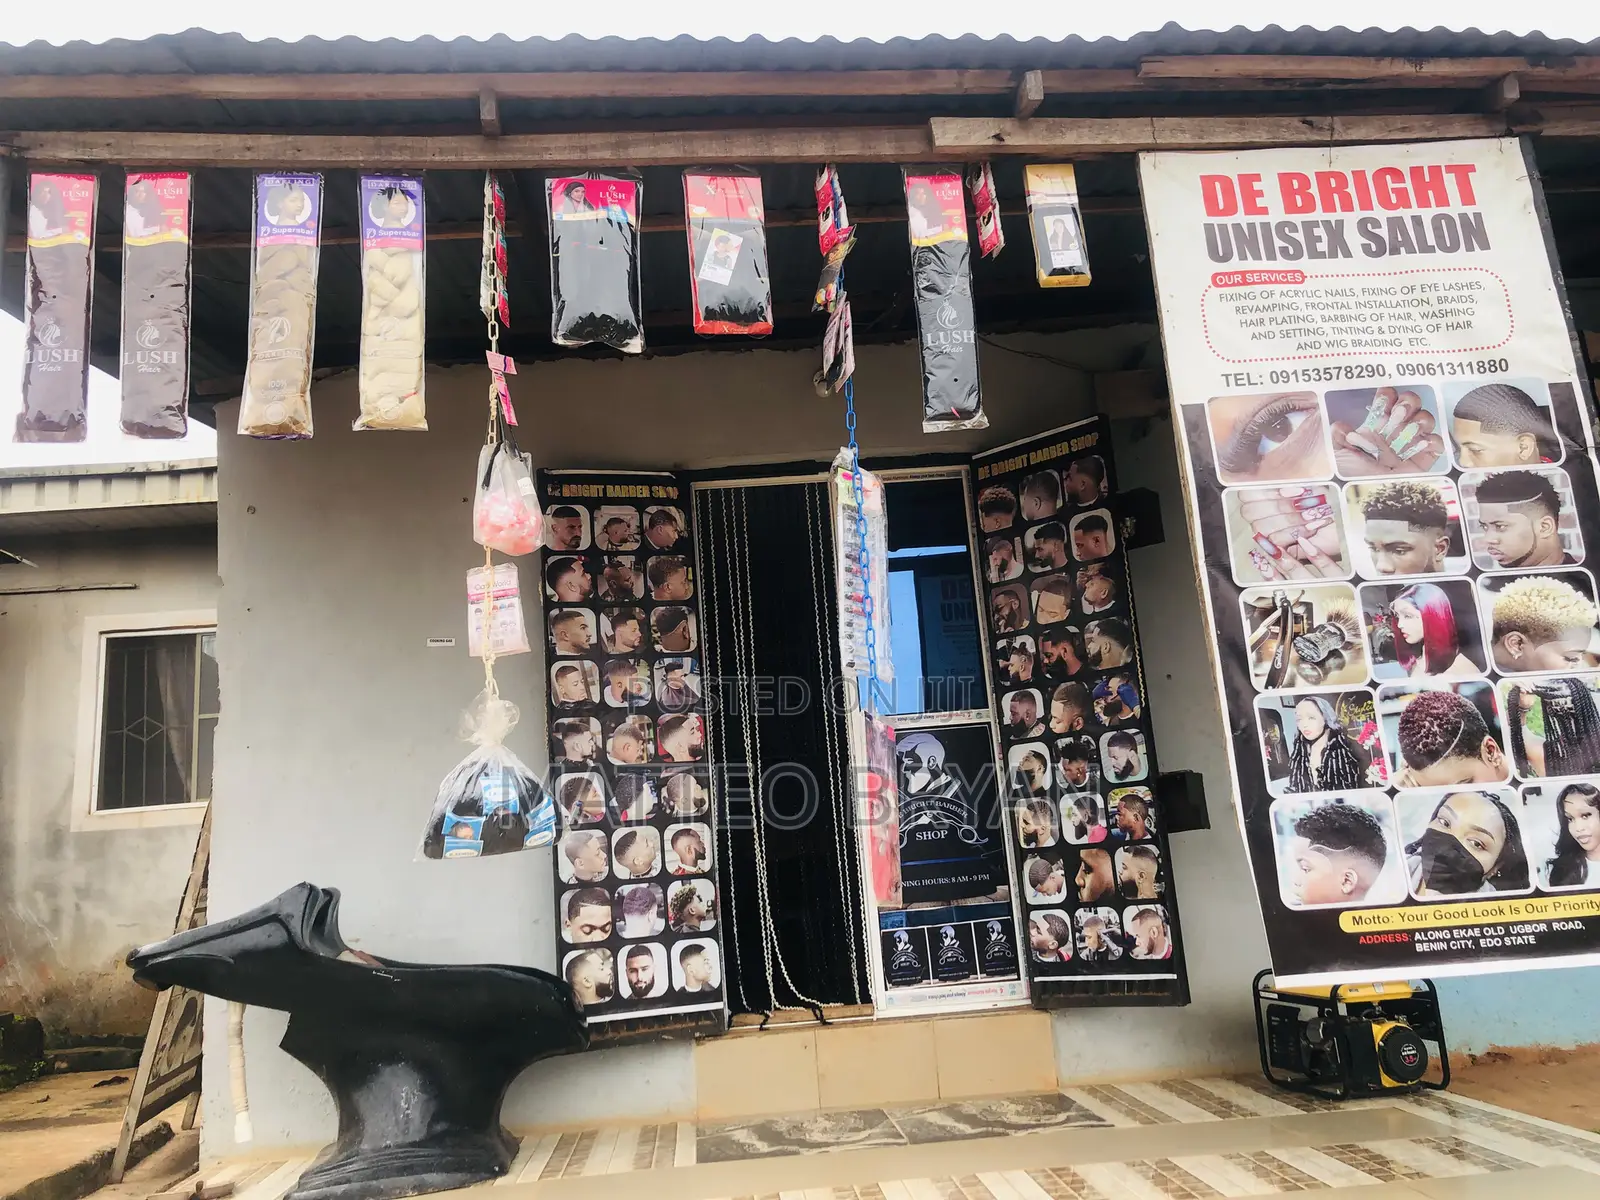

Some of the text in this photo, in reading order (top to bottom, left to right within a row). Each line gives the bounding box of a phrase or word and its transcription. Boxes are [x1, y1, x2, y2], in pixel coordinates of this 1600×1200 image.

[157, 187, 184, 195] LUSH
[600, 191, 626, 200] LUSH
[1199, 164, 1476, 217] DE BRIGHT
[1203, 212, 1491, 263] UNISEX SALON
[1216, 273, 1303, 285] OUR SERVICES
[1219, 281, 1485, 302] FIXING OF ACRYLIC NAILS, FIXING OF EYE LASHES,
[1235, 295, 1478, 315] REVAMPING, FRONTAL INSTALLATION, BRAIDS,
[1239, 308, 1475, 328] HAIR PLATING, BARBING OF HAIR, WASHING
[926, 330, 975, 346] LUSH
[1250, 321, 1474, 341] AND SETTING, TINTING & DYING OF HAIR
[941, 344, 963, 353] Hair
[1296, 338, 1431, 351] AND WIG BRAIDING ETC.
[25, 349, 78, 364] LUSH
[124, 351, 177, 366] LUSH
[37, 363, 62, 372] Hair
[137, 364, 161, 373] Hair
[1221, 358, 1509, 387] TEL: 09153578290, 09061311880
[978, 432, 1099, 480] DE BRIGHT BARBER SHOP
[562, 484, 604, 497] BRIGHT
[606, 485, 650, 497] BARBER
[651, 486, 678, 500] SHOP
[936, 801, 968, 819] BARBER
[916, 830, 948, 841] SHOP
[900, 880, 921, 888] NING
[922, 877, 951, 886] HOURS:
[956, 875, 969, 883] AM
[1352, 899, 1600, 926] Motto: Your Good Look Is Our Priority
[1359, 920, 1586, 945] ADDRESS: ALONG EKAE OLD UGBOR ROAD,
[1415, 935, 1536, 952] BENIN CITY, EDO STATE
